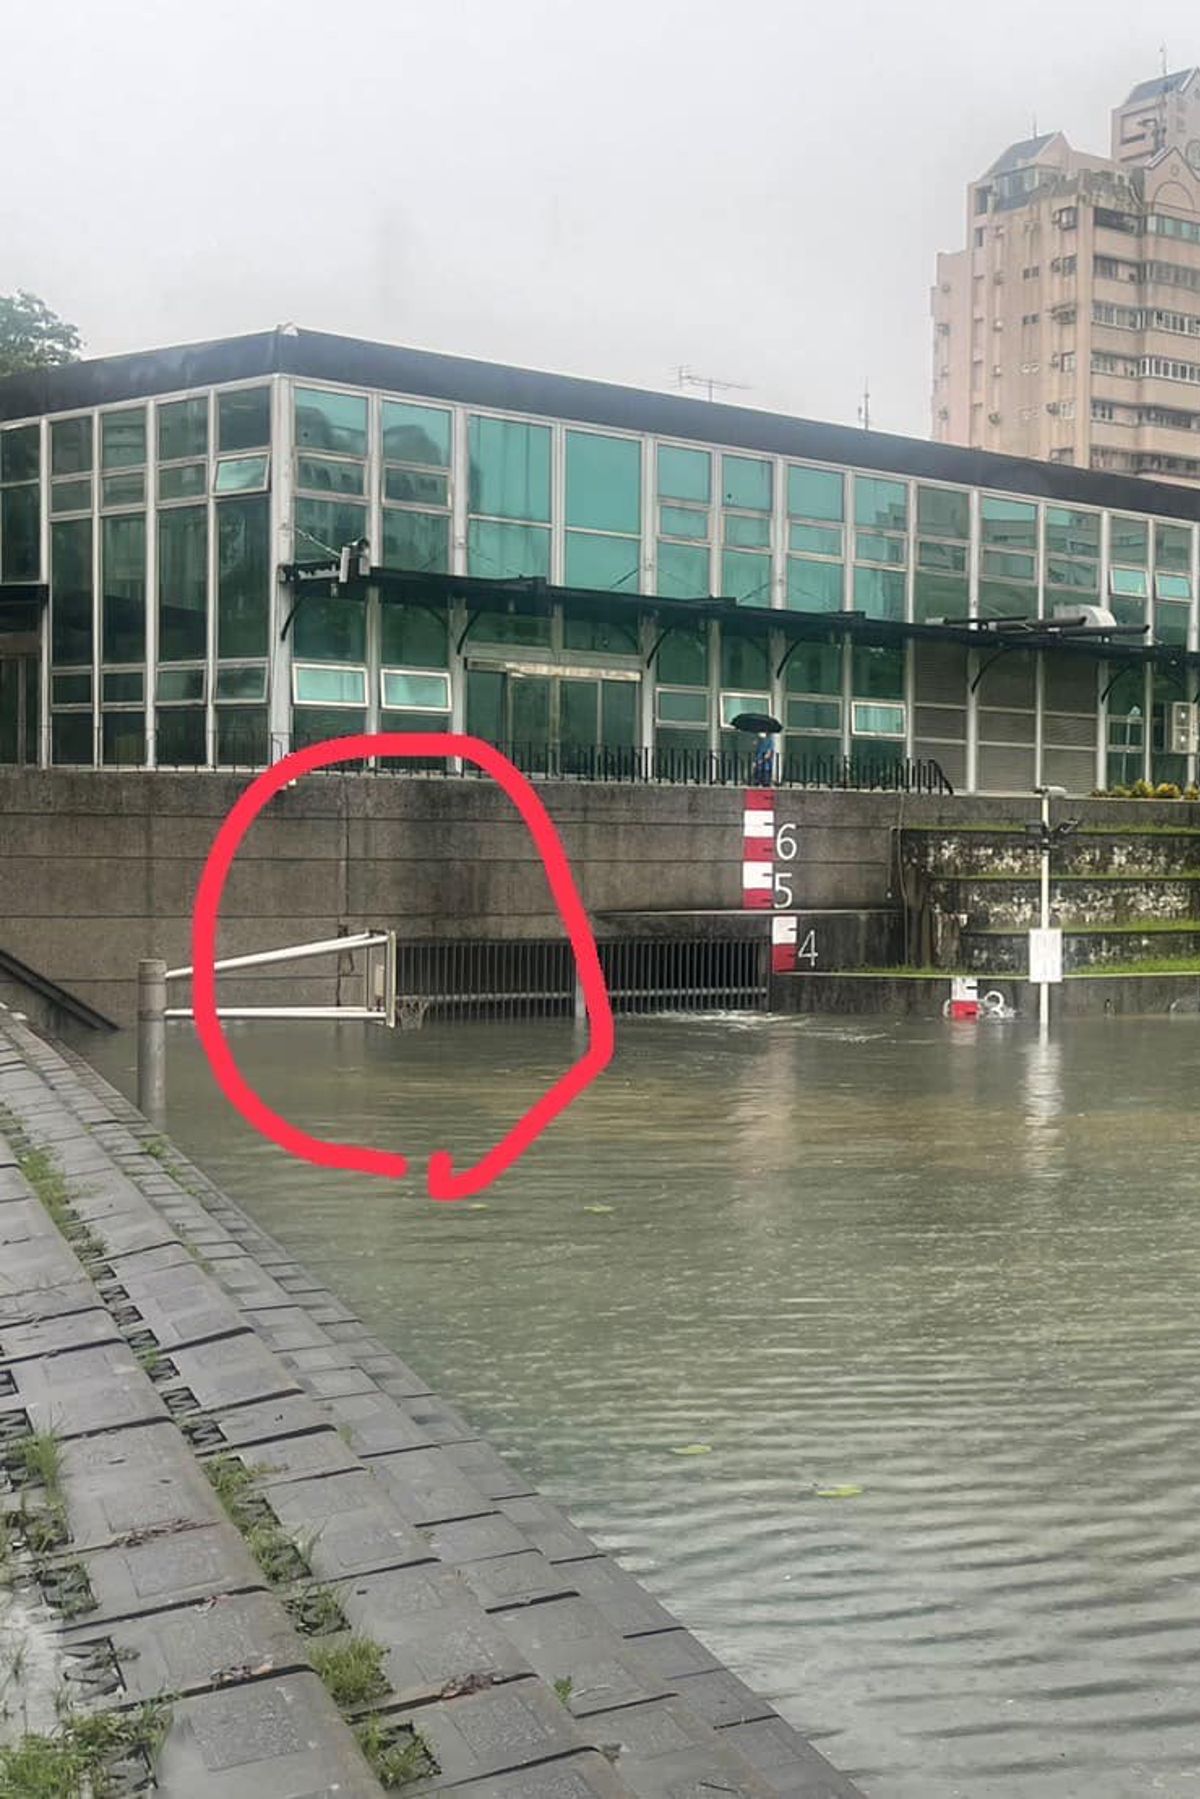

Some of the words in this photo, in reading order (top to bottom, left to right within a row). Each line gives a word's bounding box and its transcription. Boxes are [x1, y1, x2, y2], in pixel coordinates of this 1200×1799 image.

[776, 823, 797, 860] 6
[774, 873, 792, 908] 5
[798, 930, 818, 967] 4
